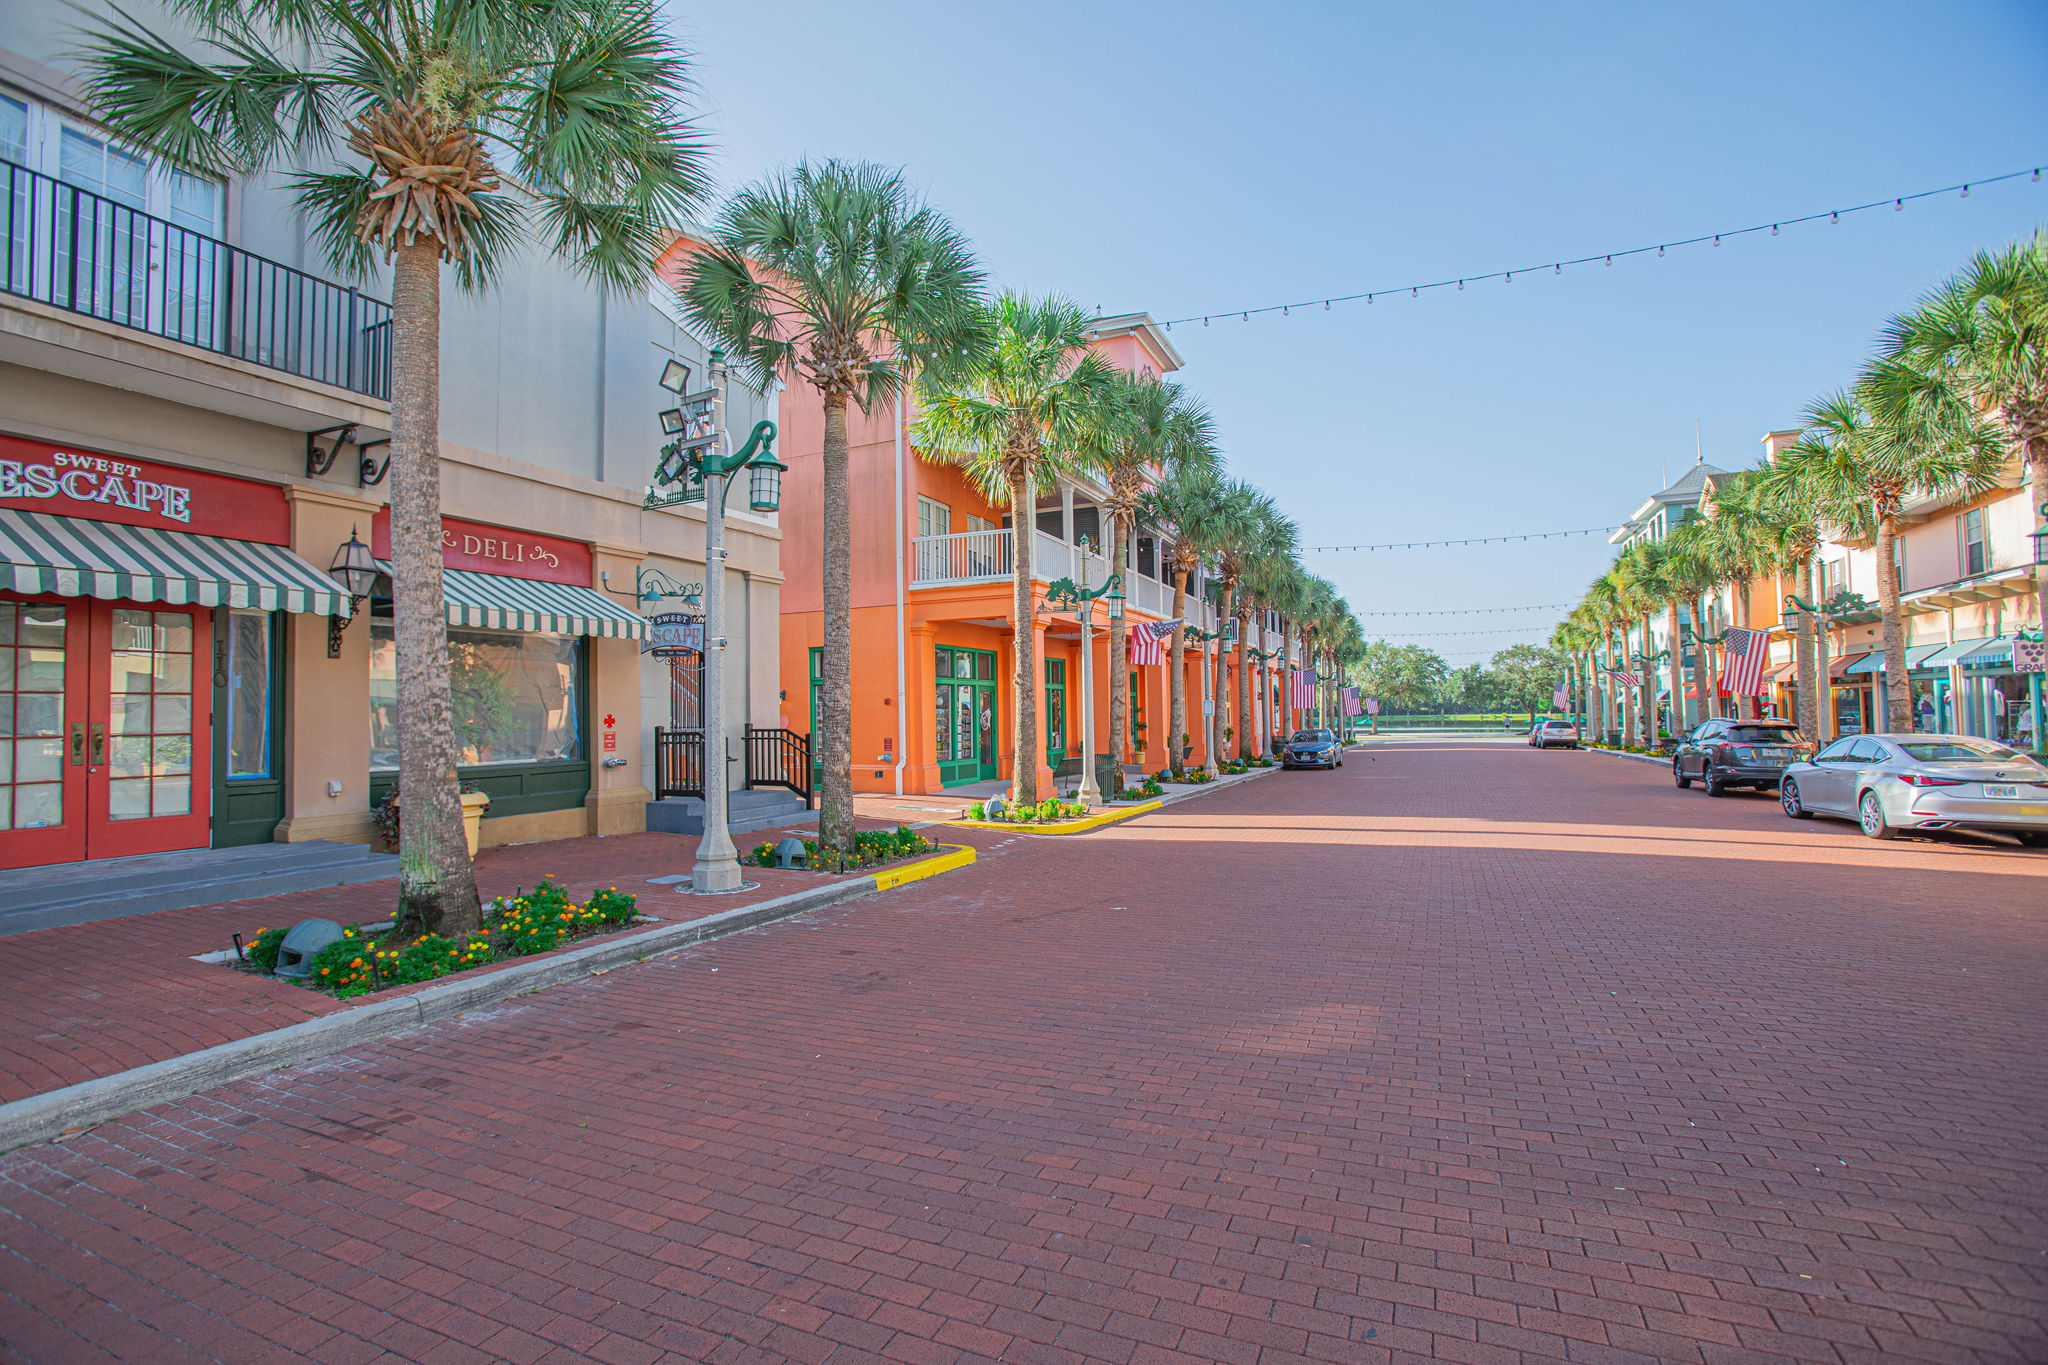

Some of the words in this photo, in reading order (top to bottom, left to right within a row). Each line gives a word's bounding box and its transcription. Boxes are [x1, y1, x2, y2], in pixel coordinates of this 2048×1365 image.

[0, 458, 191, 523] ESCAPE
[463, 534, 524, 562] DELI
[645, 628, 700, 647] SCAPE
